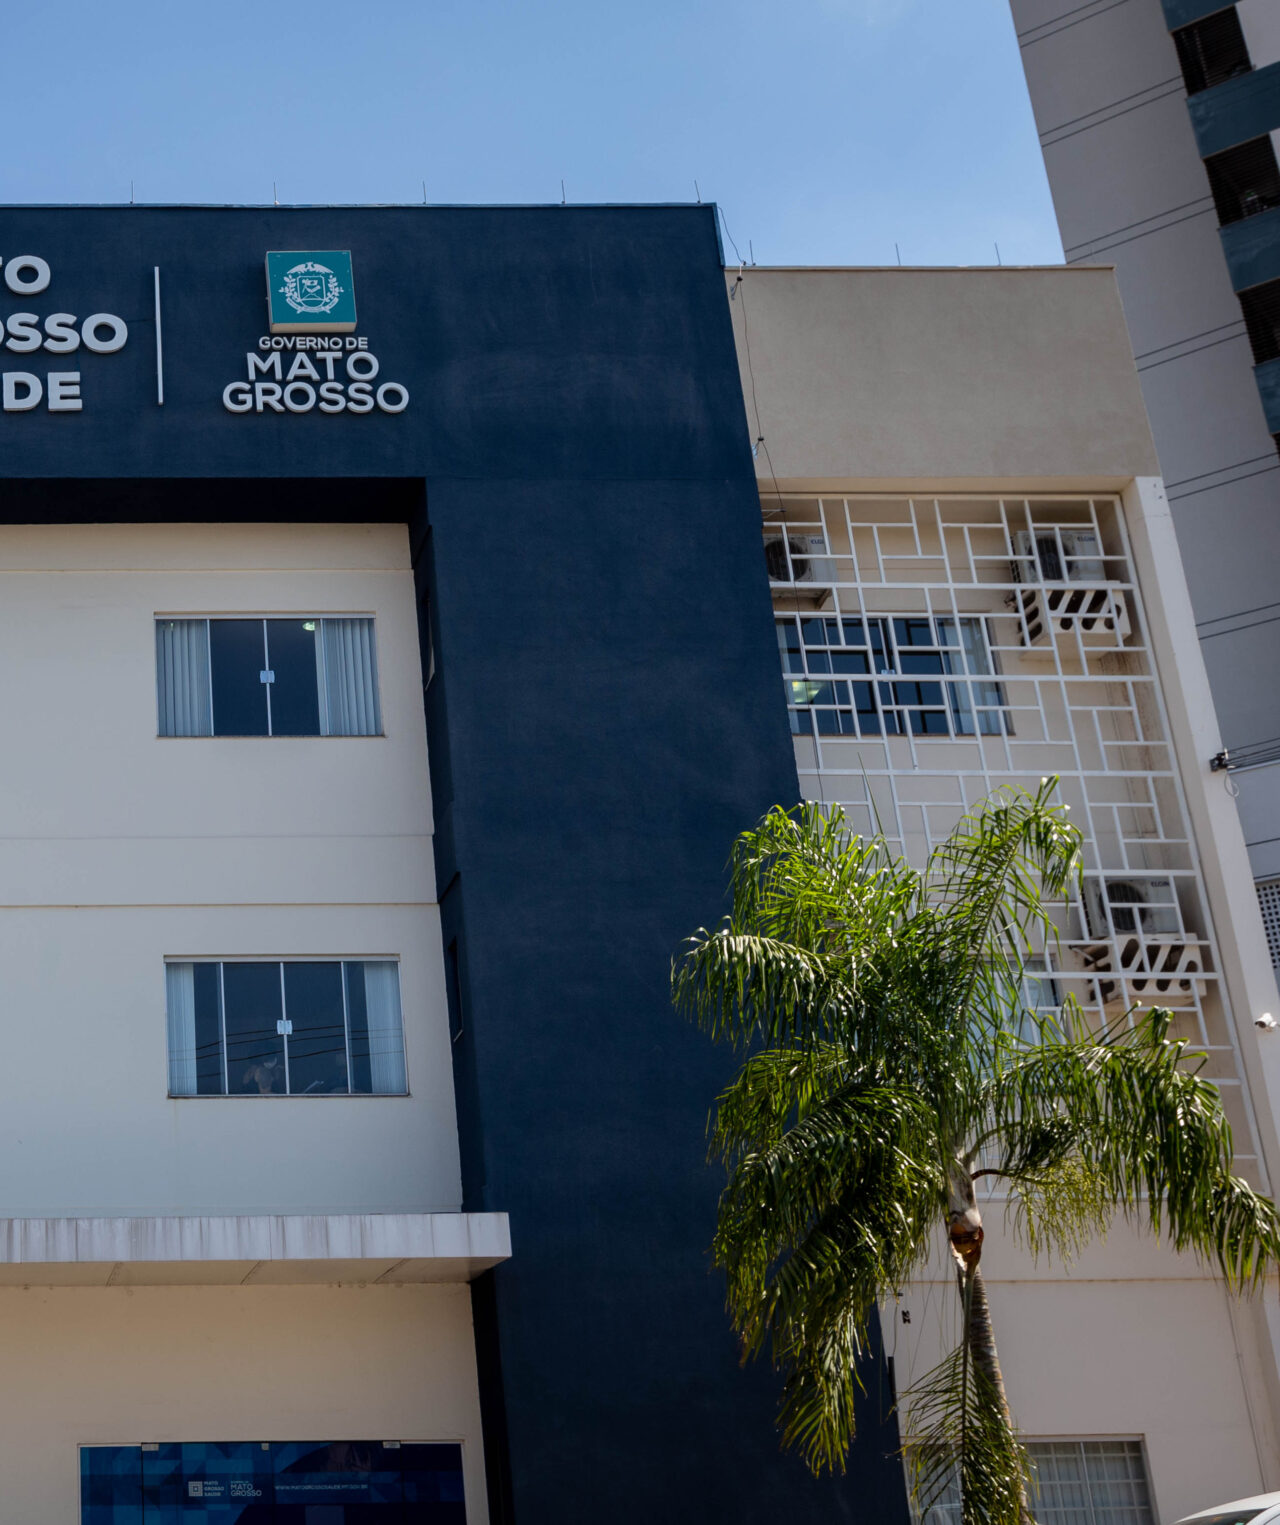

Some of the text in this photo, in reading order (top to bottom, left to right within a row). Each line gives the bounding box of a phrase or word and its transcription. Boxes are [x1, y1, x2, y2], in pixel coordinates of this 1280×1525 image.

[259, 336, 368, 350] GOVERNO DE
[246, 351, 379, 382] MATO
[222, 381, 409, 413] GROSSO
